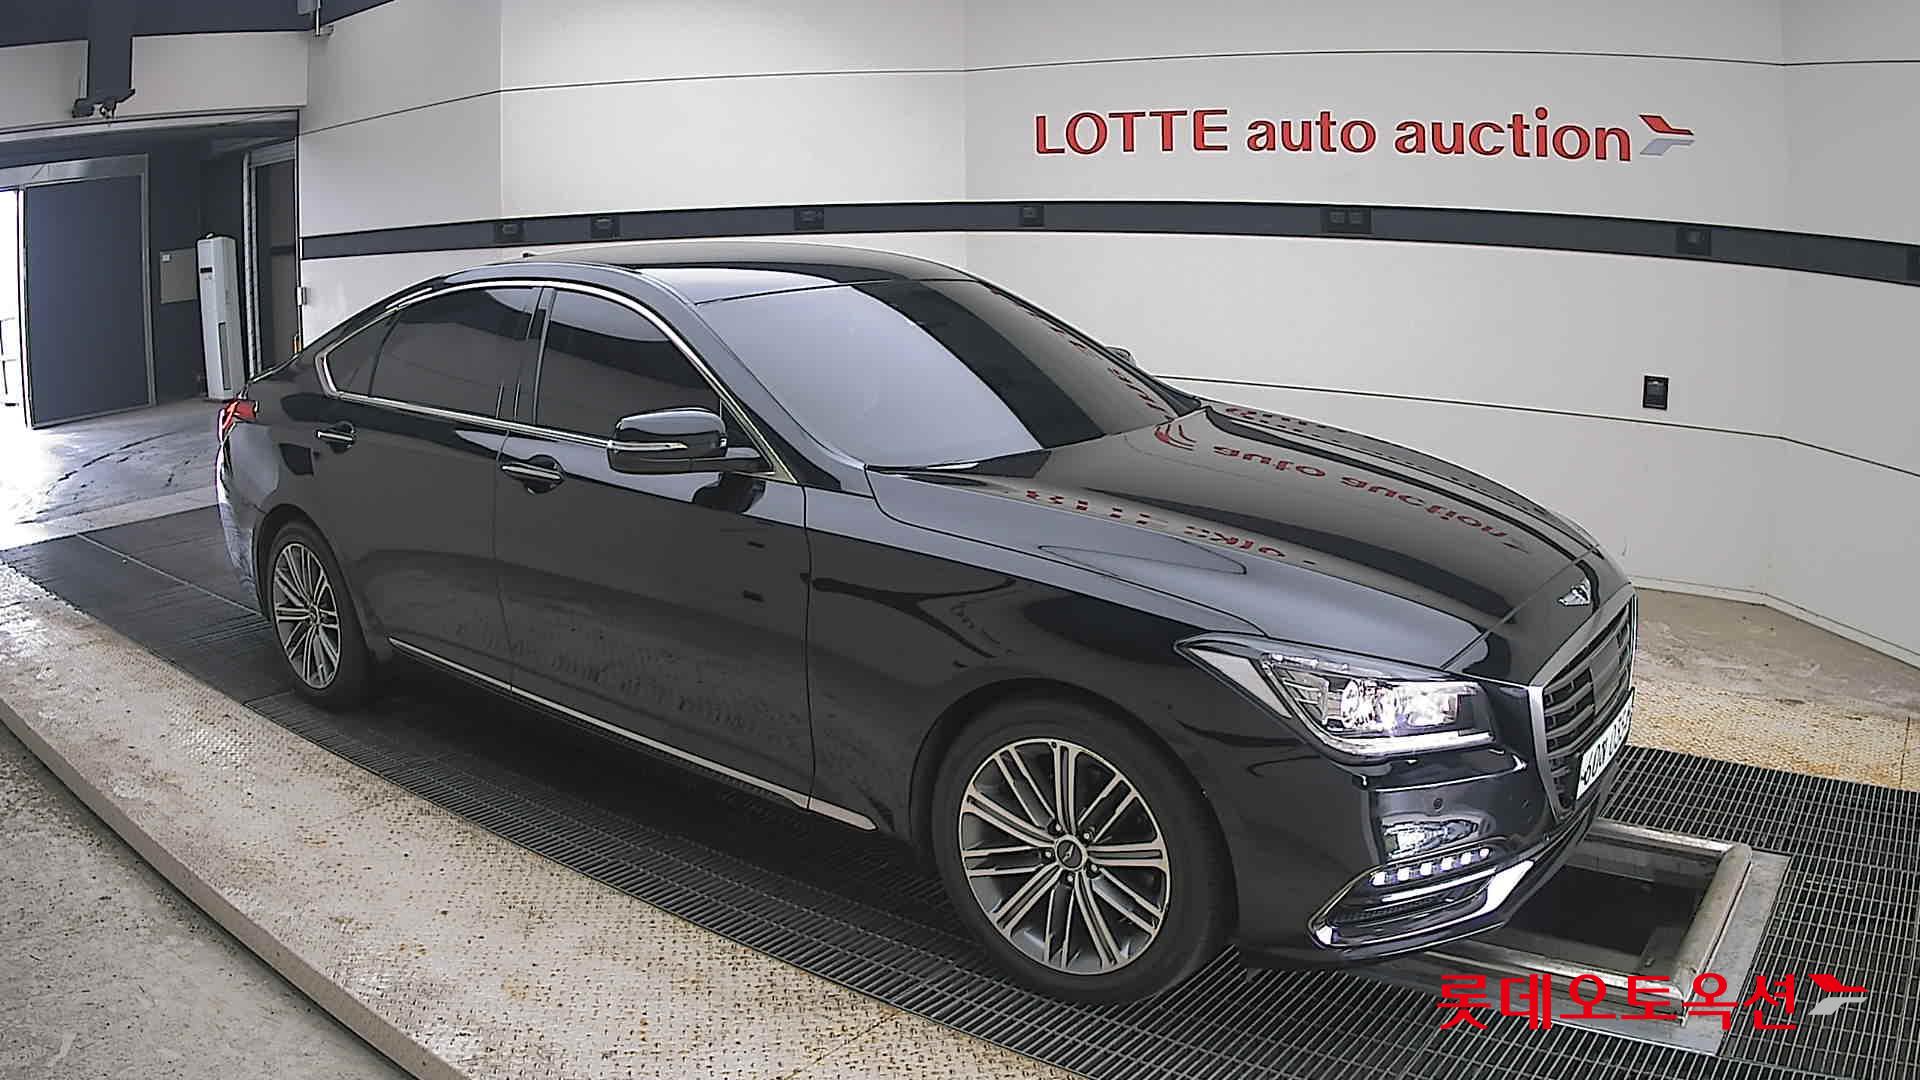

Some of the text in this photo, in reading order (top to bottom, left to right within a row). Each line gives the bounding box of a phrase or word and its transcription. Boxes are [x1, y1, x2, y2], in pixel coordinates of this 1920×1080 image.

[1035, 107, 1632, 161] LOTTE auto auction
